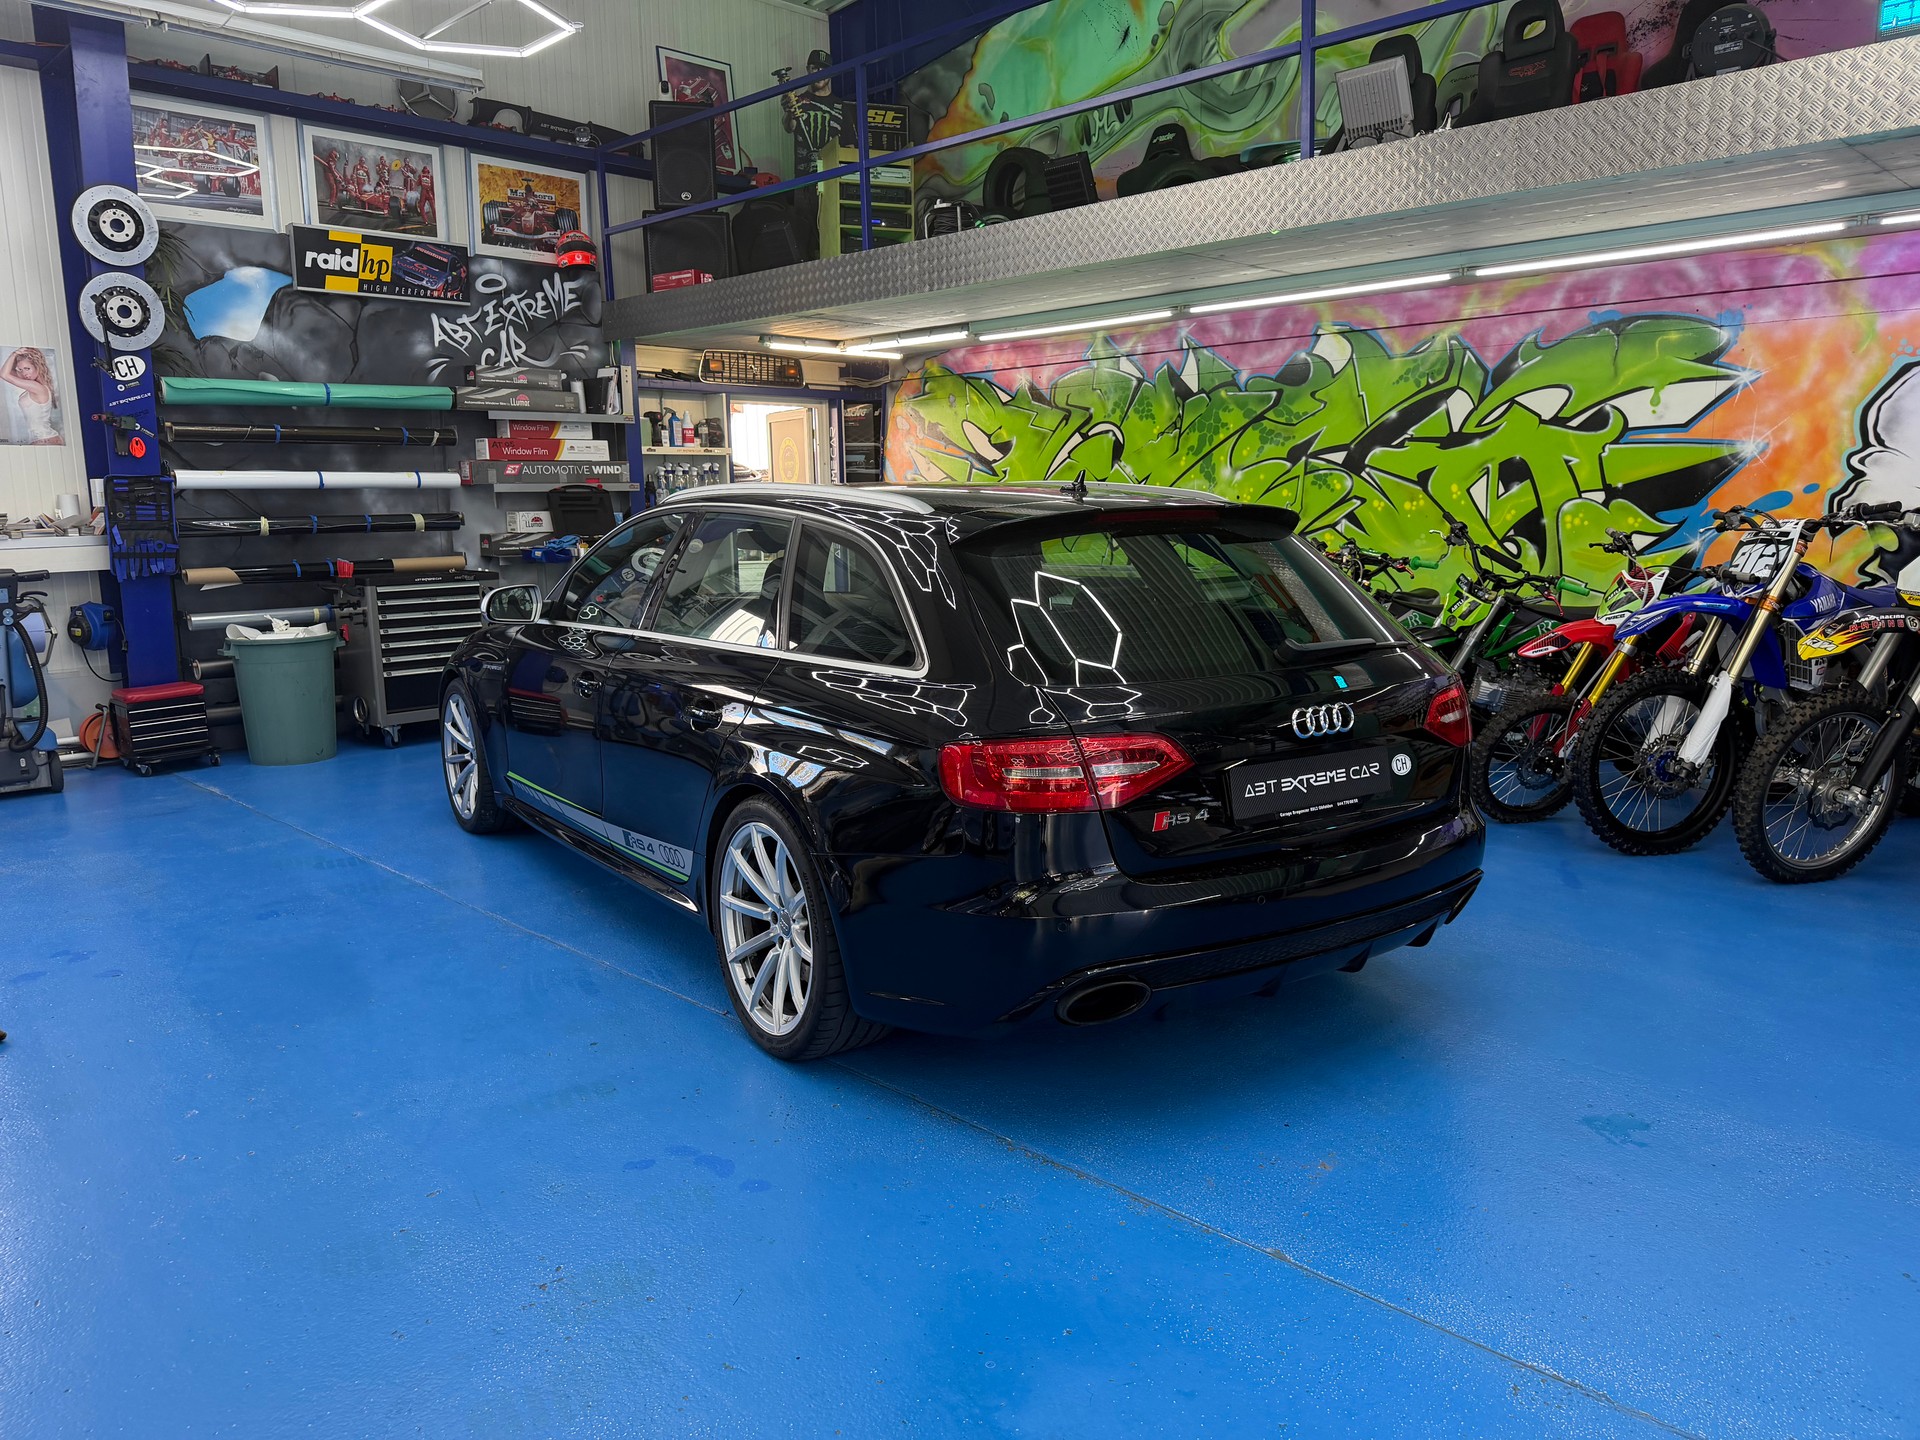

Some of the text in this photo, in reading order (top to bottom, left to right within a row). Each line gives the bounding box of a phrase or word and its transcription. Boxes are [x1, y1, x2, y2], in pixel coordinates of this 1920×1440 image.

[305, 248, 391, 281] raid hp
[363, 283, 463, 300] HIGH PERFORMANCE
[430, 272, 583, 357] ABT EXTREME
[481, 326, 544, 368] CAR
[114, 358, 139, 378] CH
[512, 424, 550, 432] Window Film
[502, 447, 549, 456] Window Film
[522, 465, 590, 475] AUTOMOTIVE
[592, 465, 622, 475] WIND
[1810, 593, 1837, 613] YAMAHA
[1395, 757, 1408, 772] CH
[1244, 762, 1380, 798] ABT EXTREME CAR
